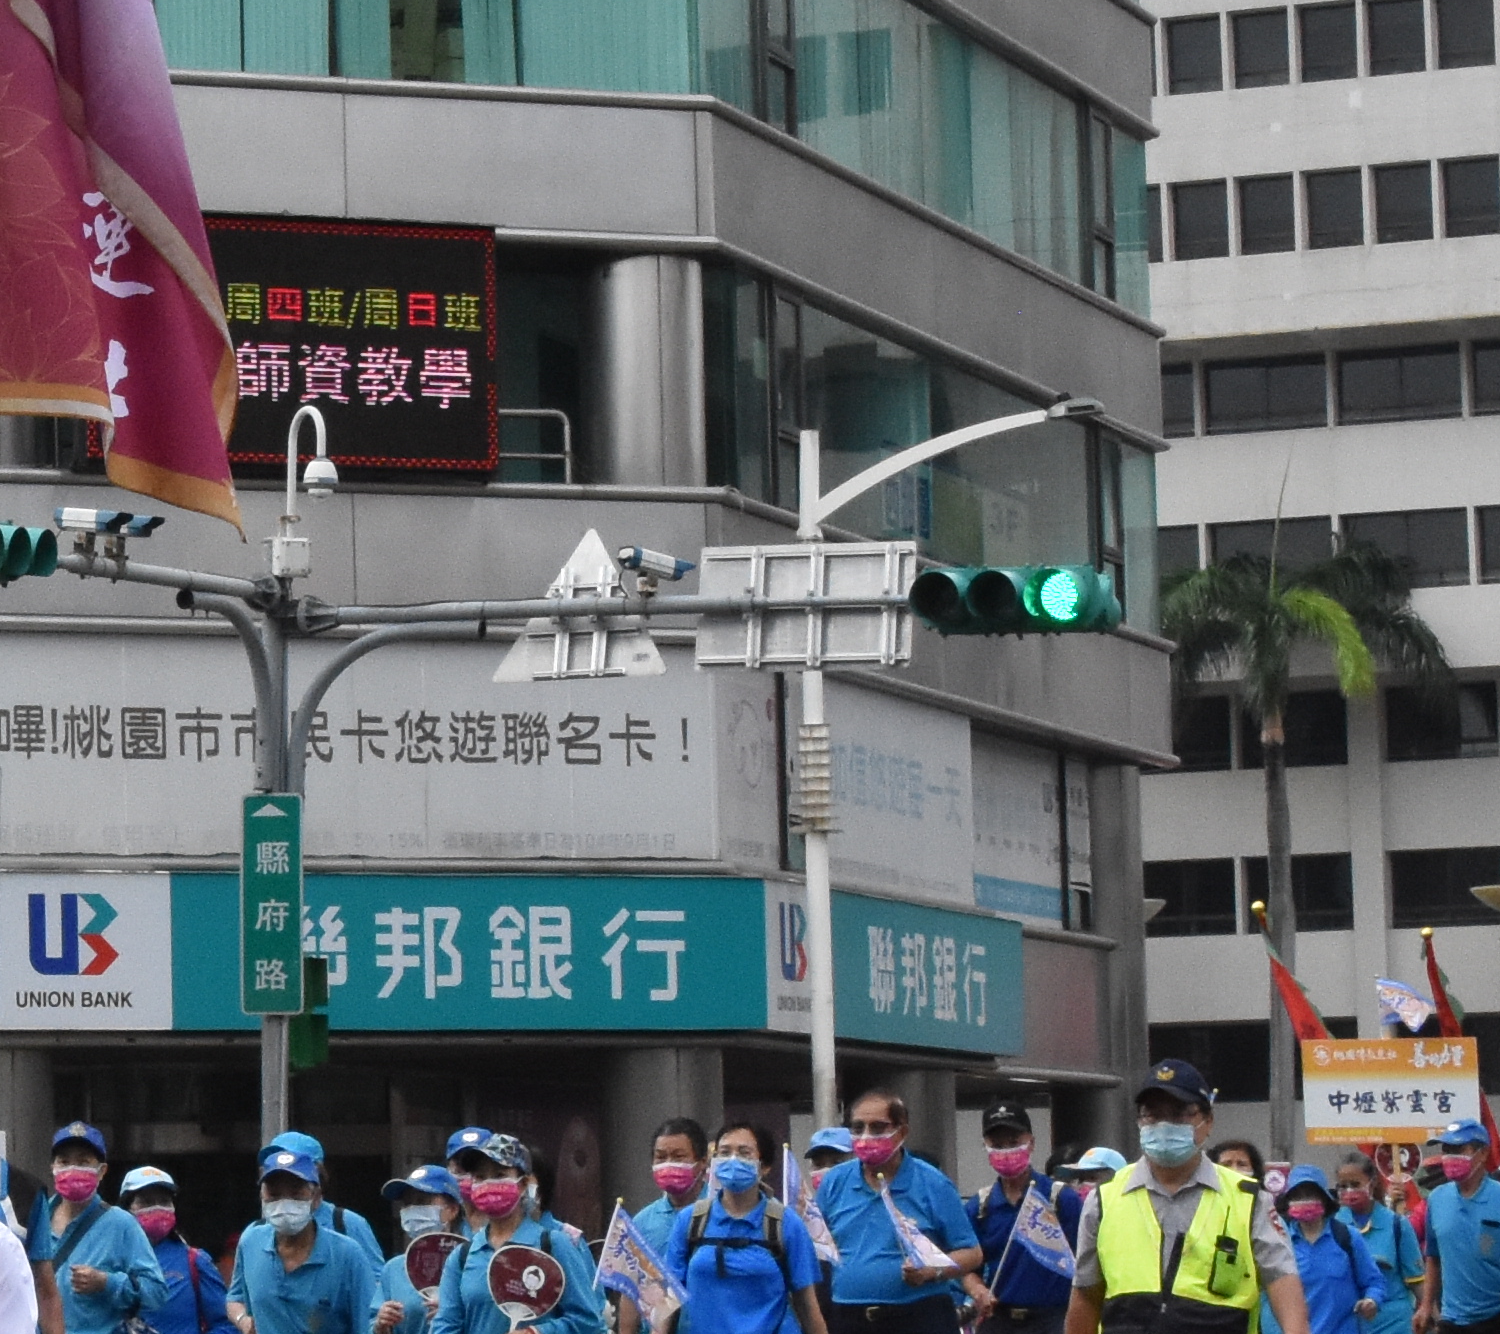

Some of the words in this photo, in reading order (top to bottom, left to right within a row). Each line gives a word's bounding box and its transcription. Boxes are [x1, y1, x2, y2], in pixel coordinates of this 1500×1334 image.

[236, 342, 472, 408] 師資教學
[255, 841, 290, 992] 縣府路
[16, 991, 75, 1008] UNION
[80, 991, 133, 1009] BANK
[868, 924, 987, 1028] 聯邦銀行
[1328, 1089, 1456, 1114] 中壢紫雲宮
